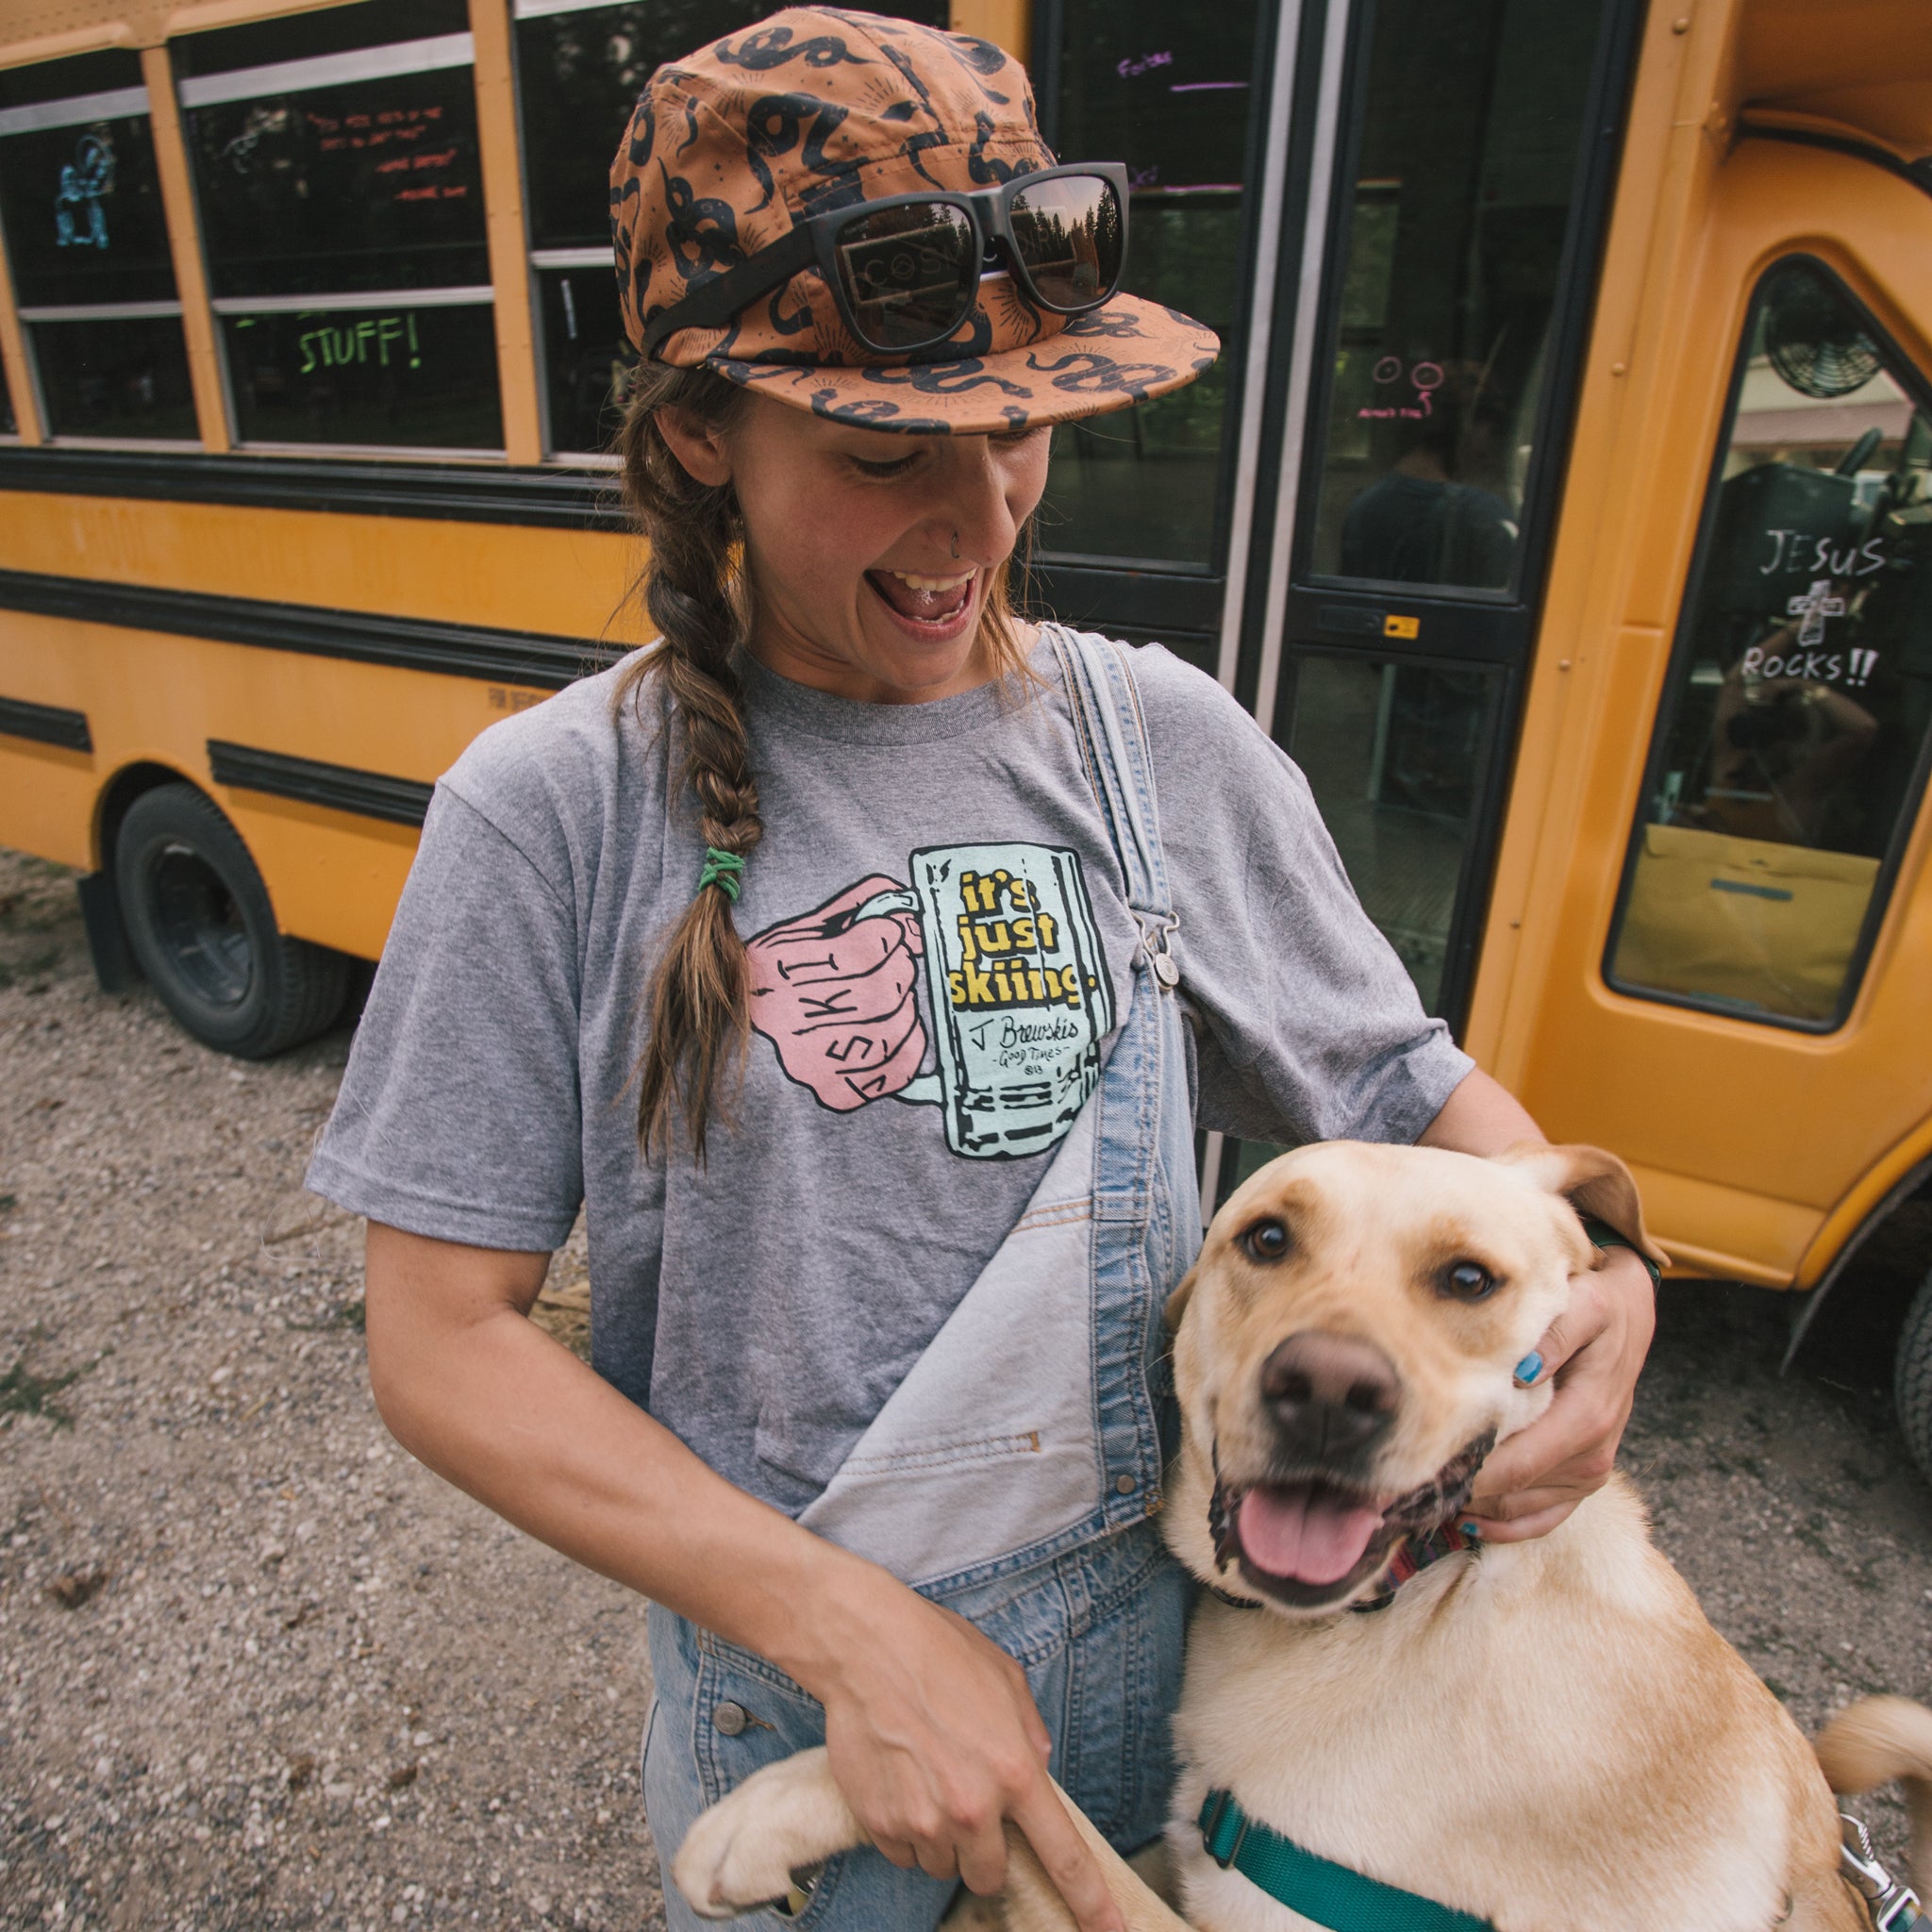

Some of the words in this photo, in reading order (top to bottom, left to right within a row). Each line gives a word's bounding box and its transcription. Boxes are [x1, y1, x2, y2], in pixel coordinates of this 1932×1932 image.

[299, 312, 422, 374] STUFF!
[1759, 529, 1886, 575] JESUS
[960, 869, 1041, 913] it's
[957, 912, 1060, 964] just
[948, 956, 1099, 1011] skiing.
[969, 1019, 994, 1051] J
[999, 1015, 1079, 1048] Brewskis
